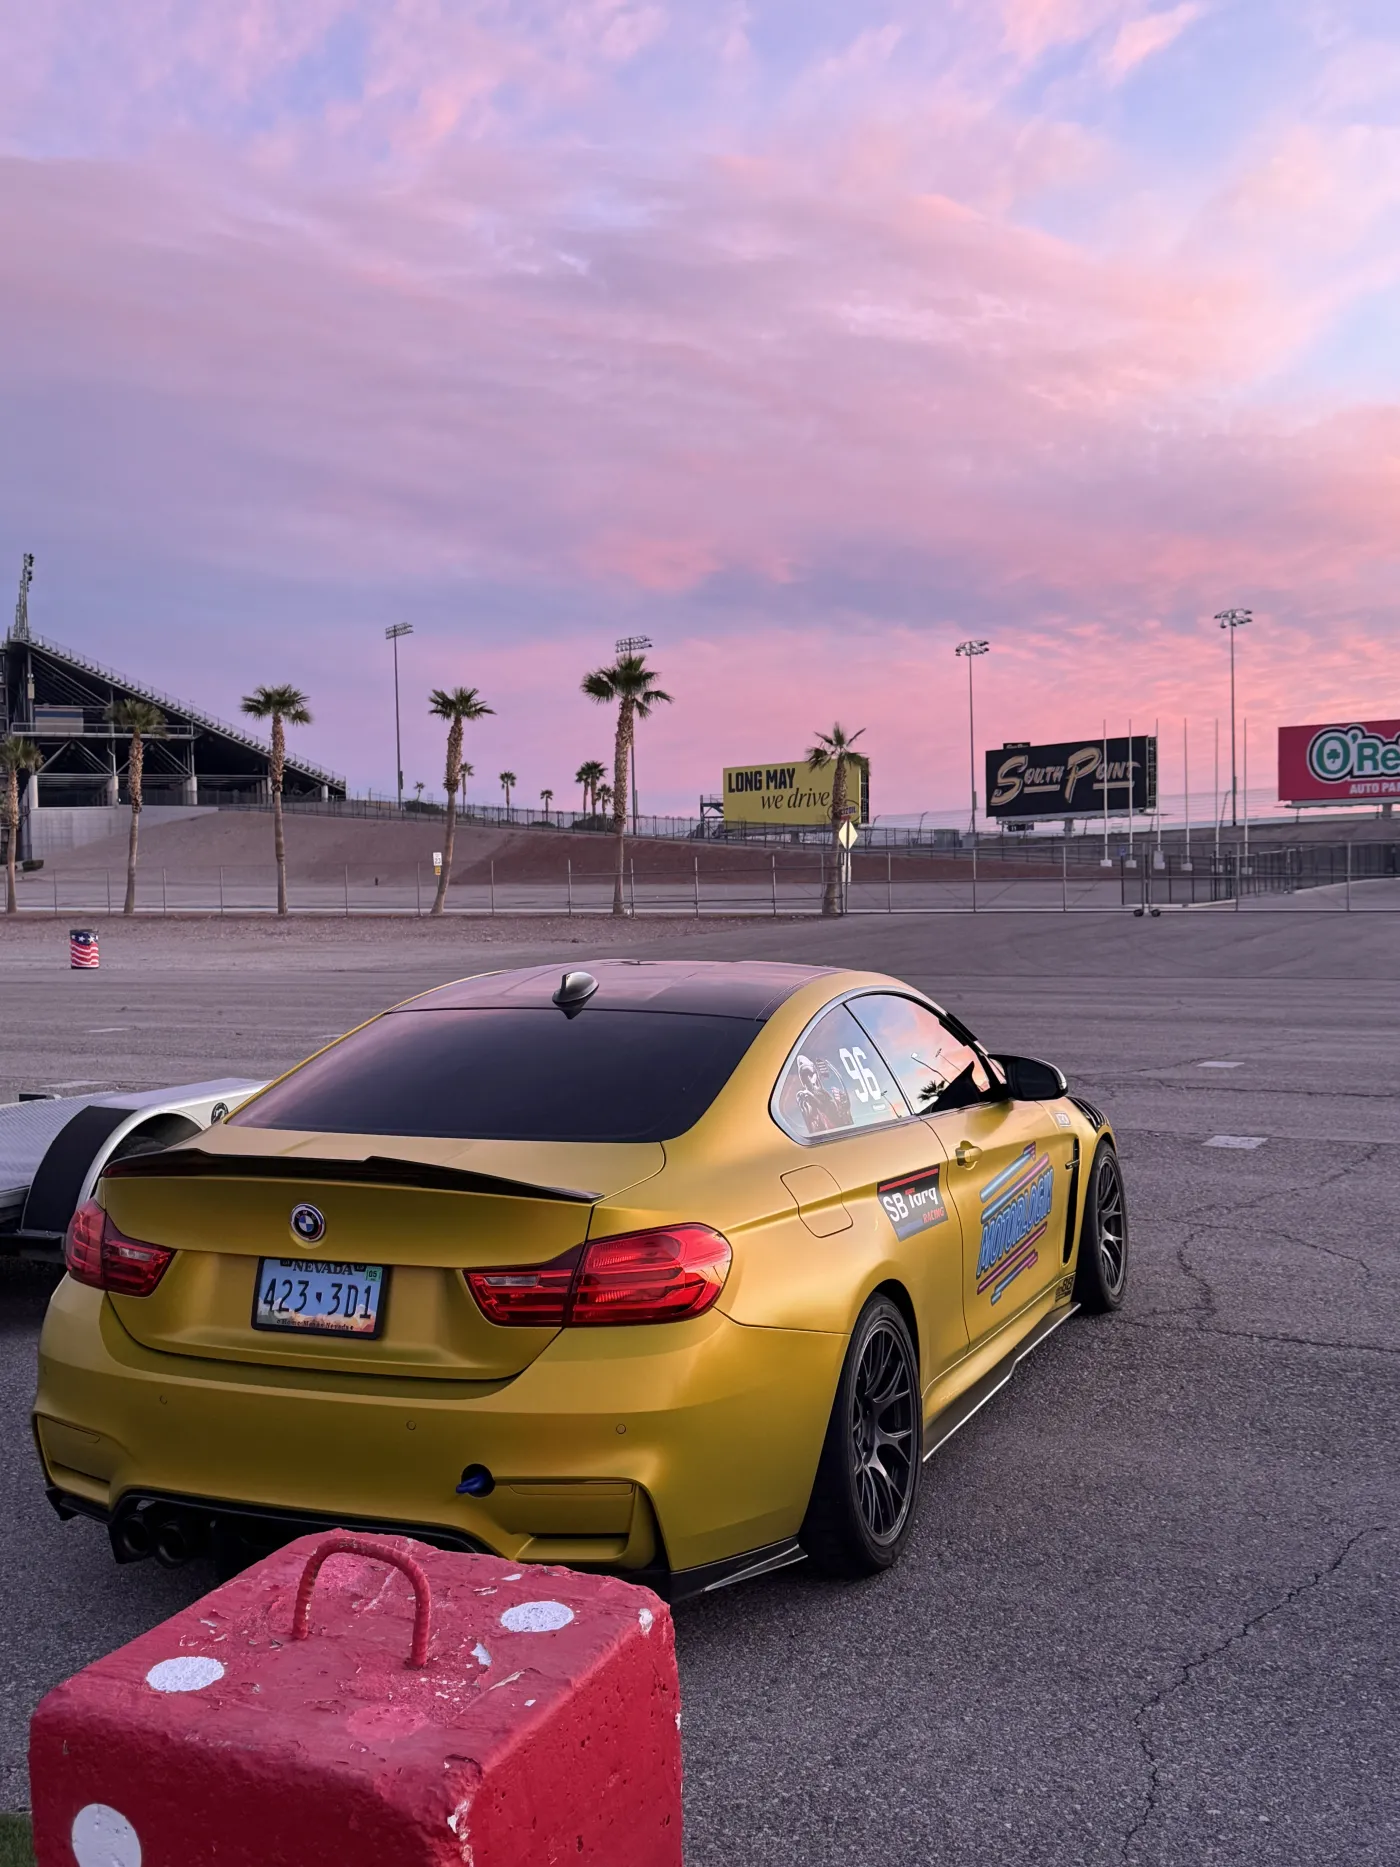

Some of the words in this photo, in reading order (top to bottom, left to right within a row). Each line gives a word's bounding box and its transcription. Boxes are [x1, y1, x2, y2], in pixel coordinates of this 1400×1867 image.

[728, 770, 763, 793] LONG
[766, 767, 796, 791] MAY
[990, 754, 1065, 806] SOUTH
[1349, 782, 1380, 795] AUTO
[761, 793, 784, 810] we
[787, 787, 830, 809] drive
[838, 1046, 883, 1103] 96
[882, 1192, 909, 1222] SB
[922, 1206, 945, 1224] RACING
[292, 1260, 354, 1276] NEVADA
[368, 1270, 378, 1278] 05
[263, 1278, 310, 1313] 423
[327, 1283, 372, 1320] 3D1
[281, 1318, 300, 1326] Home
[325, 1322, 349, 1331] Nevada
